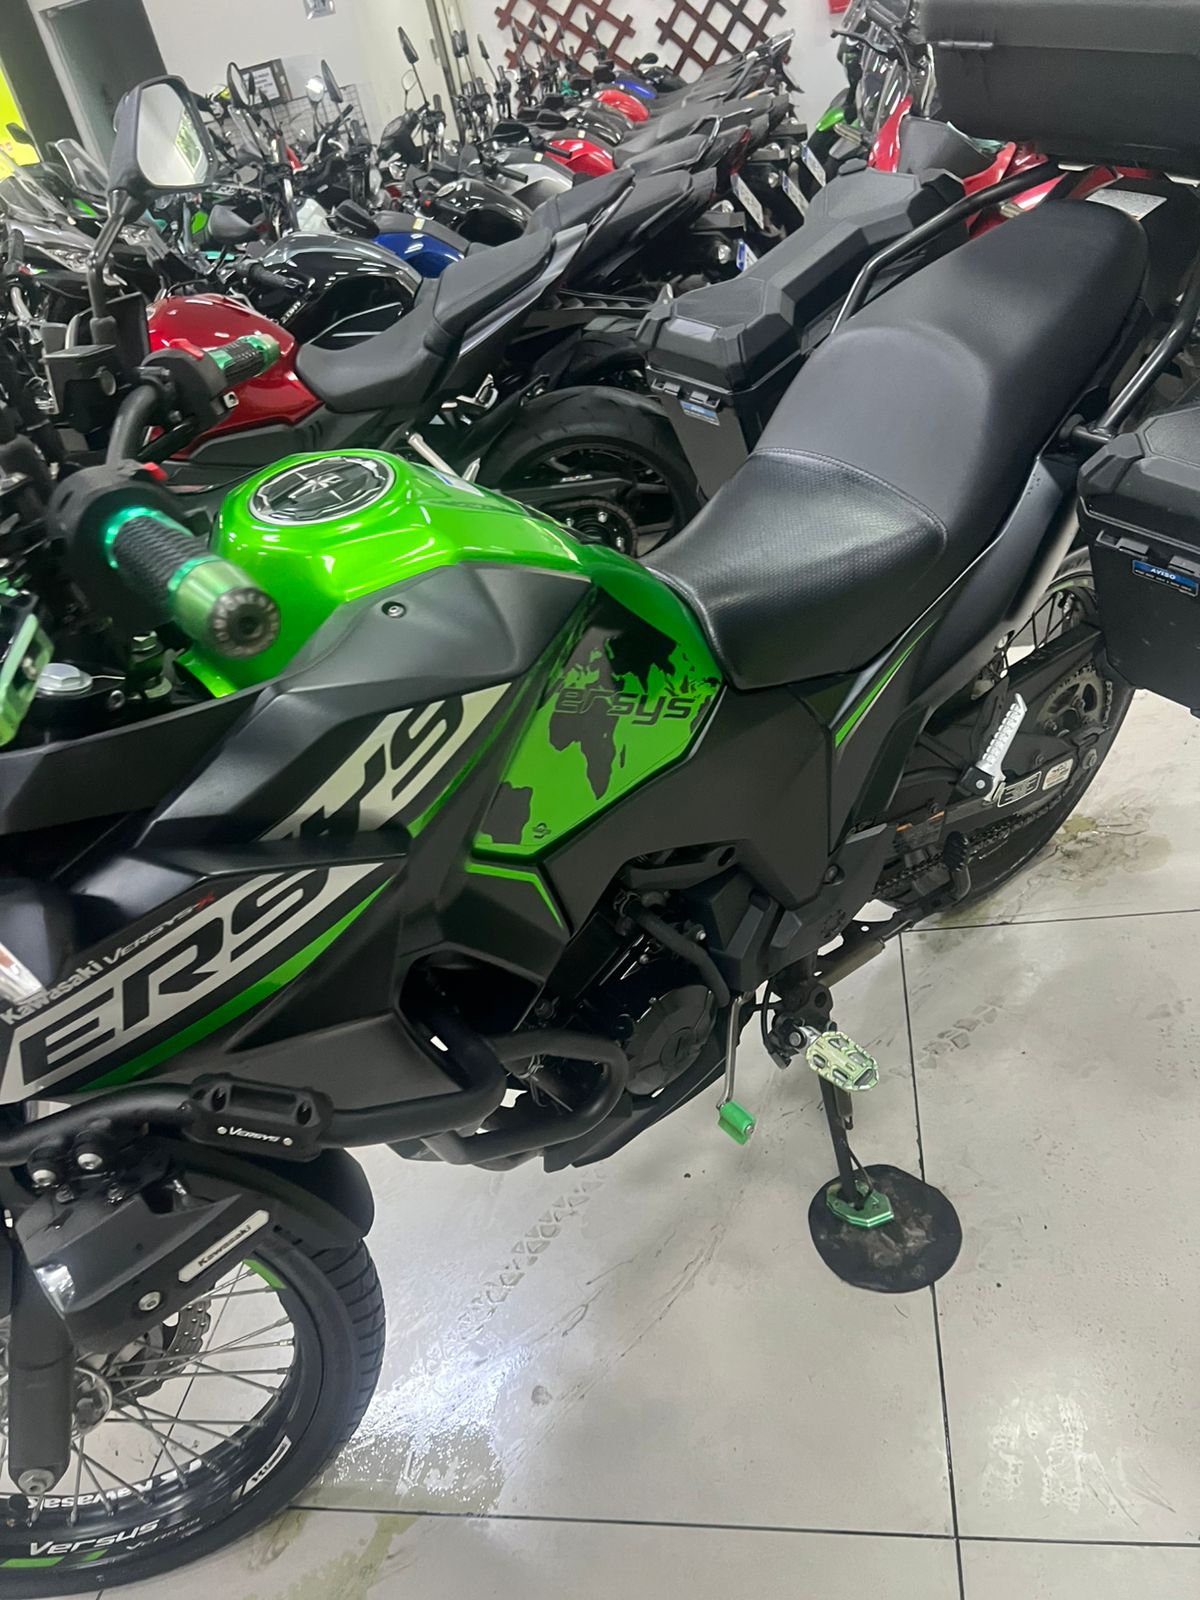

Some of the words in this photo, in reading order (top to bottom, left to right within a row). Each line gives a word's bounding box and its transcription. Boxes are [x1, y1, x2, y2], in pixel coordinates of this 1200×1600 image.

[1150, 568, 1176, 580] AVISO
[0, 960, 104, 1025] Kawasaki
[198, 1225, 251, 1267] Kawasaki
